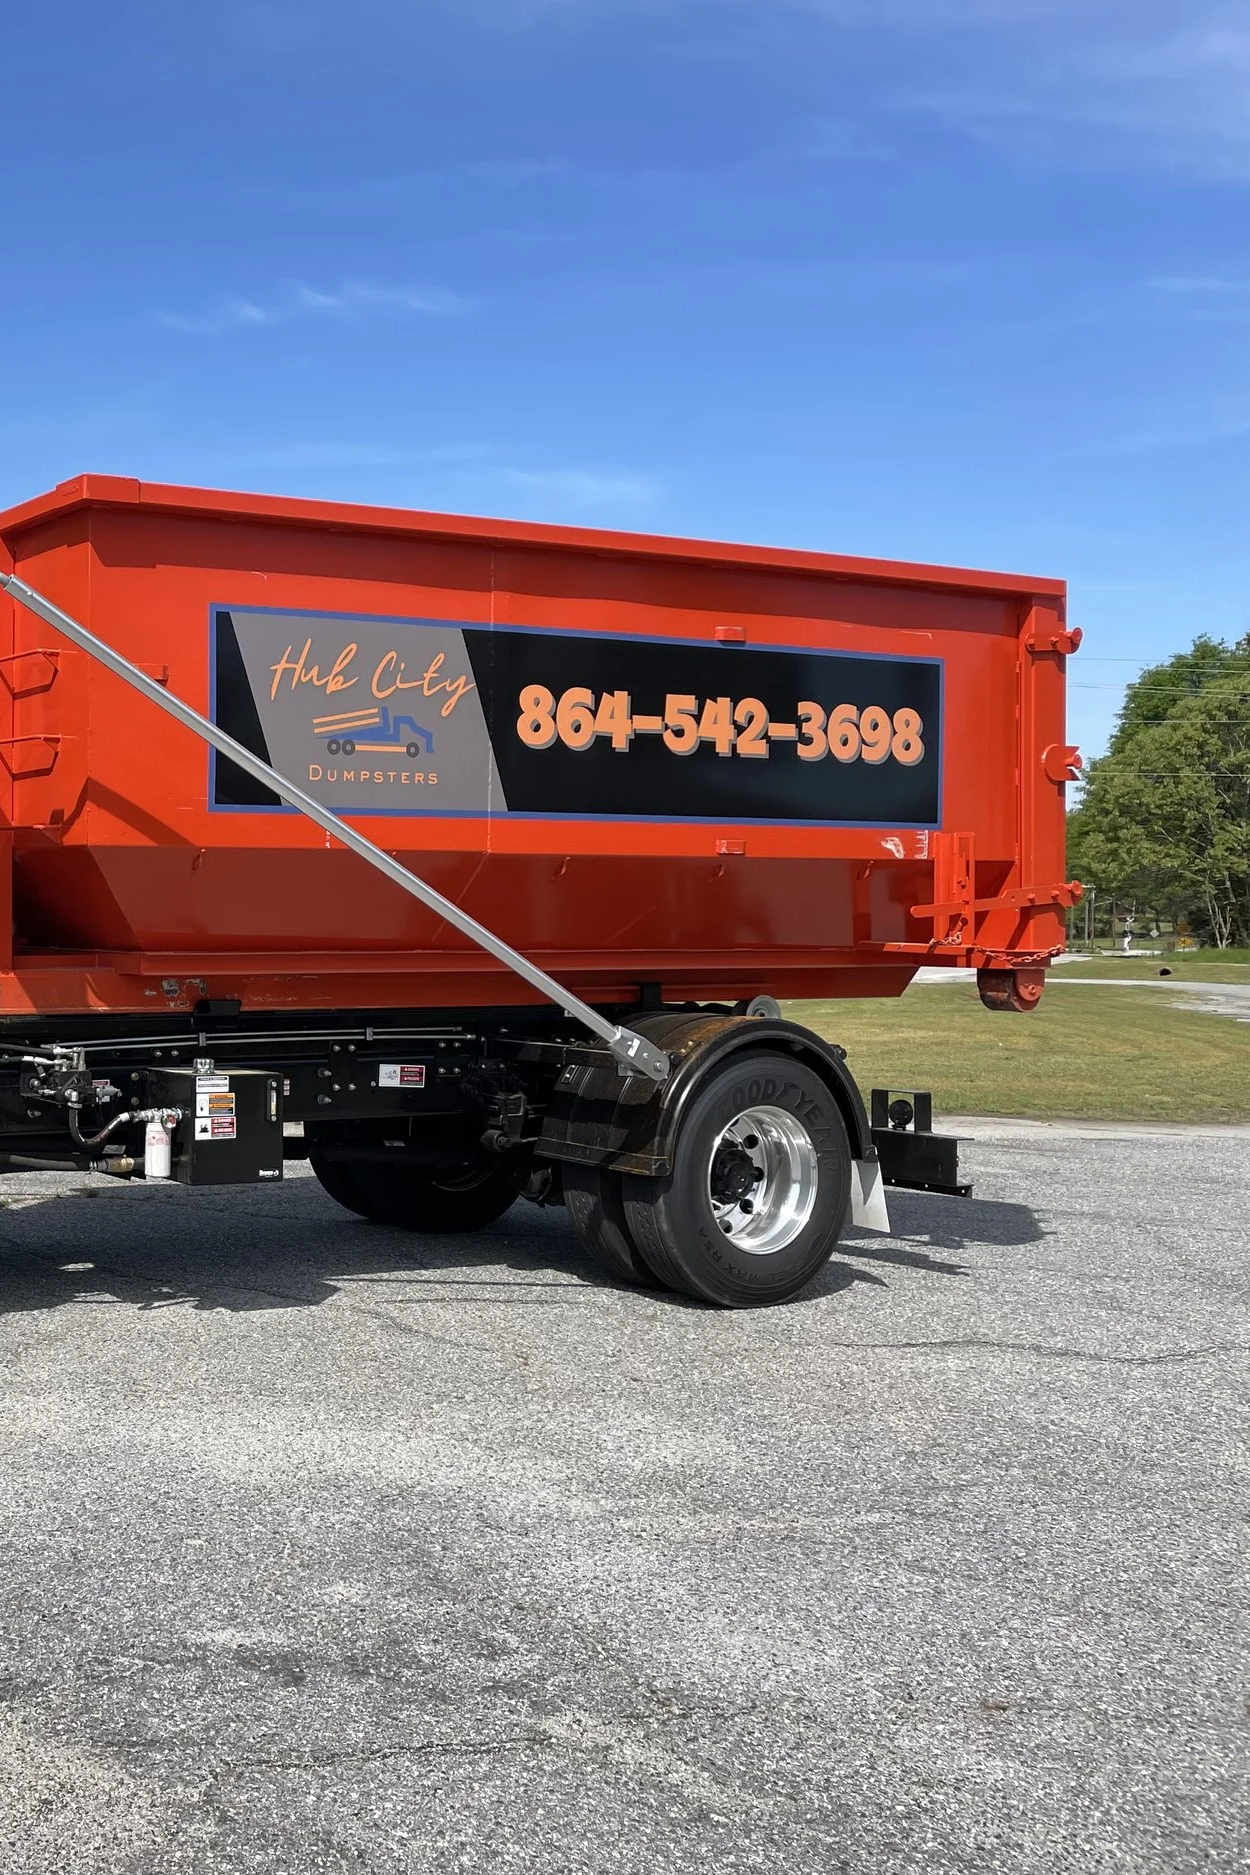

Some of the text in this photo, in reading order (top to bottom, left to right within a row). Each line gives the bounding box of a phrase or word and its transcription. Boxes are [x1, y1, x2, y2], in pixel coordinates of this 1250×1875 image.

[271, 639, 477, 717] Hub City
[516, 684, 925, 767] 864-542-3698
[309, 764, 439, 785] DUMPSTERS
